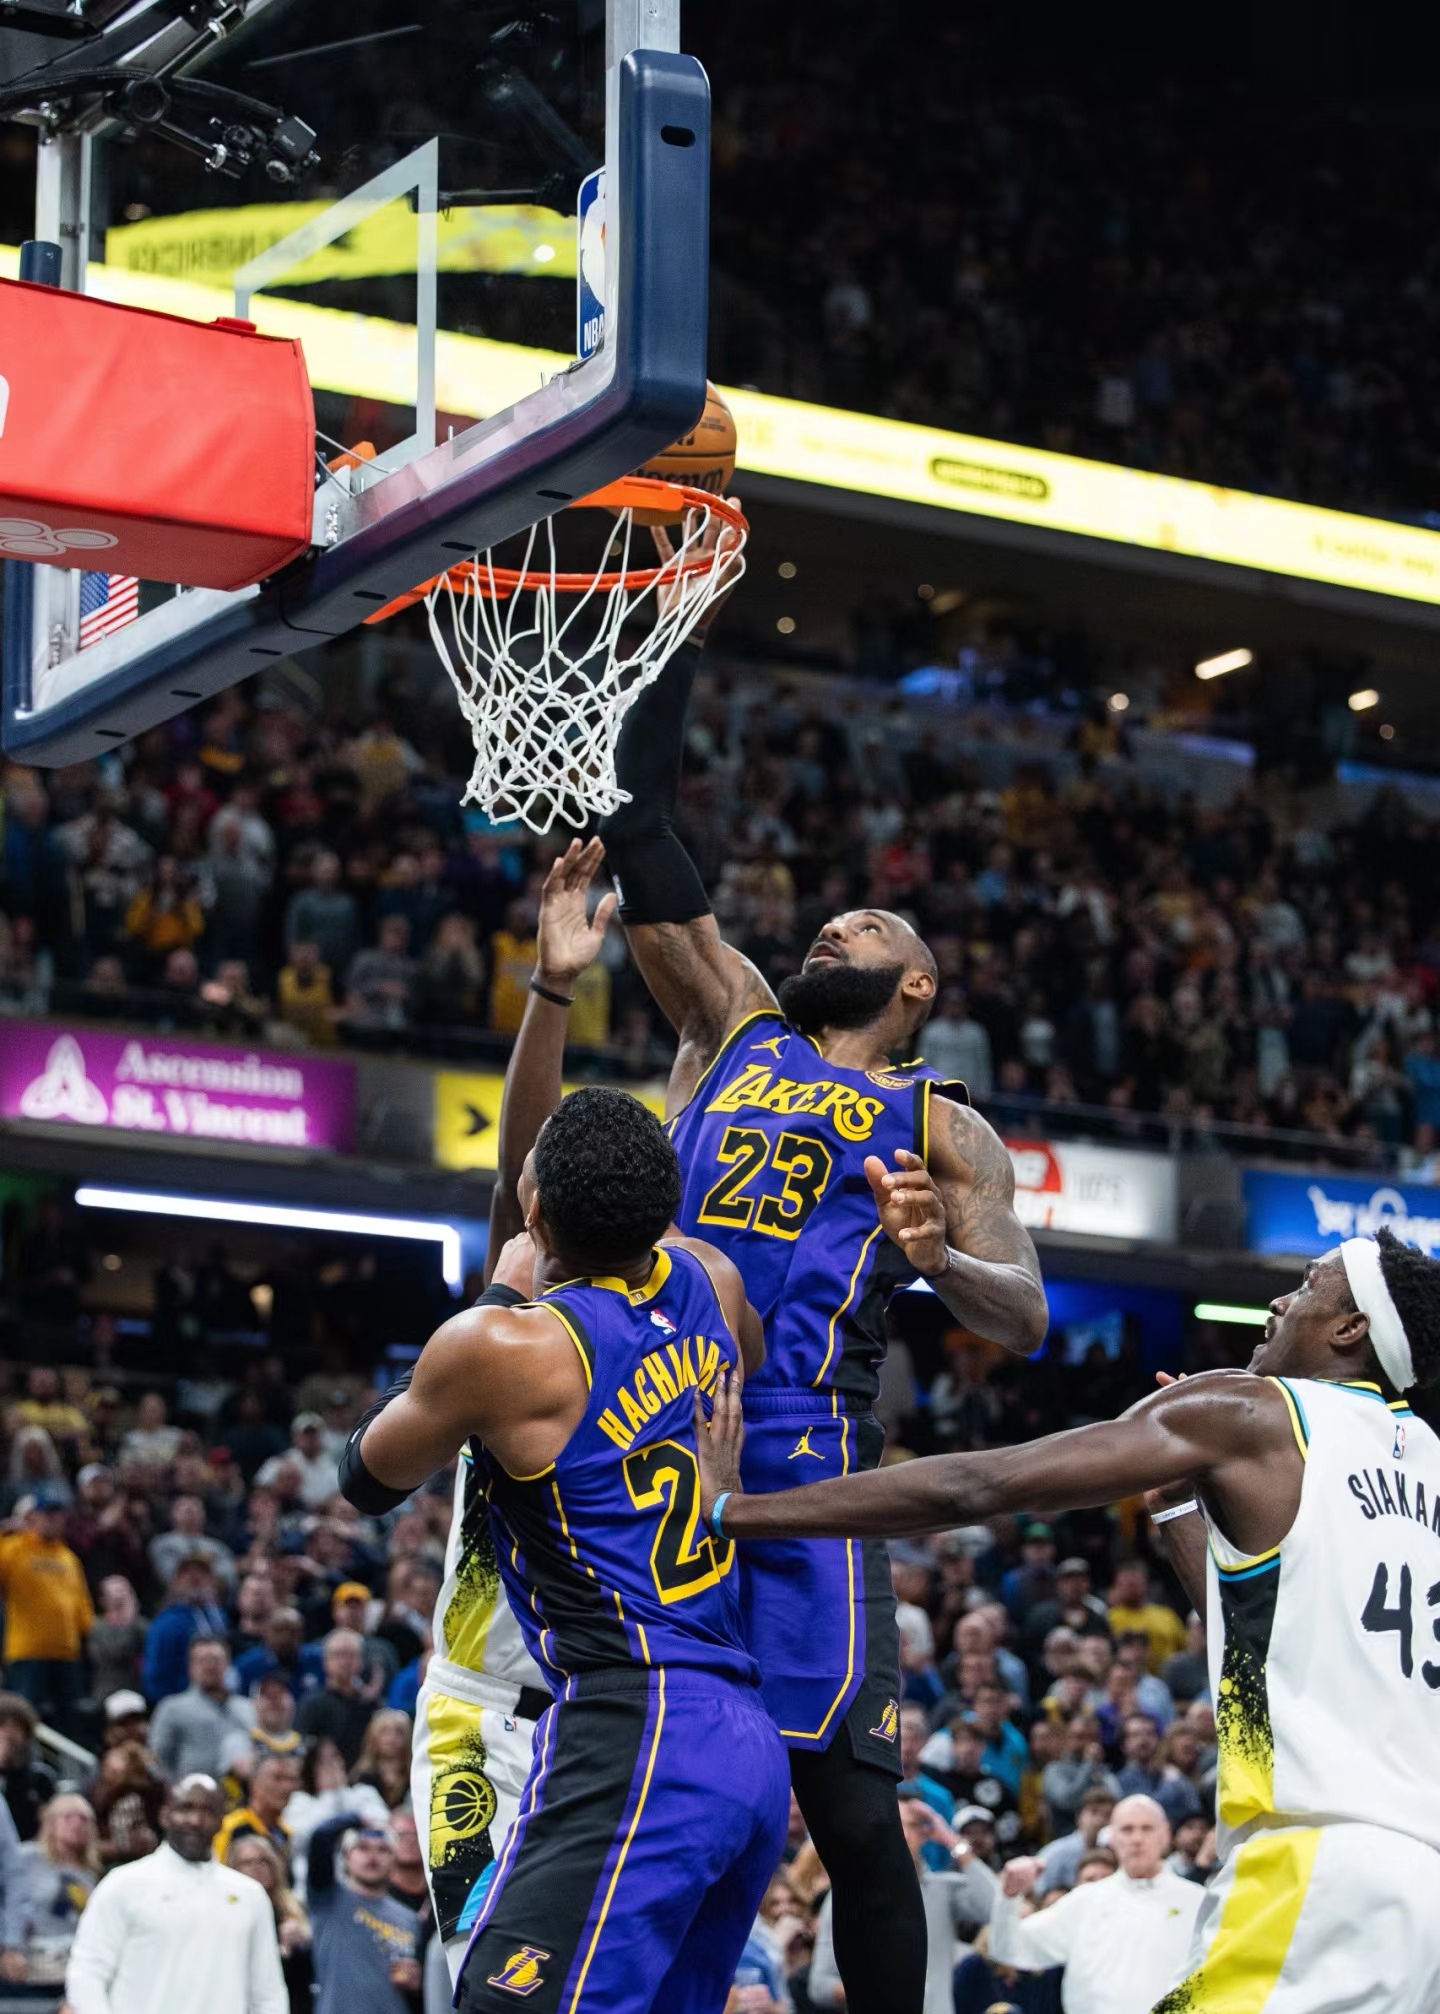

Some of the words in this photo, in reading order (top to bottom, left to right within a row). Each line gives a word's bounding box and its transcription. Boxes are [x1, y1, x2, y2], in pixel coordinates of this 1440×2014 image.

[115, 1040, 305, 1100] Ascension
[704, 1063, 886, 1142] LAKERS
[112, 1084, 167, 1131] St.
[163, 1088, 308, 1146] Vincent
[697, 1126, 833, 1241] 23
[622, 1438, 736, 1605] 2
